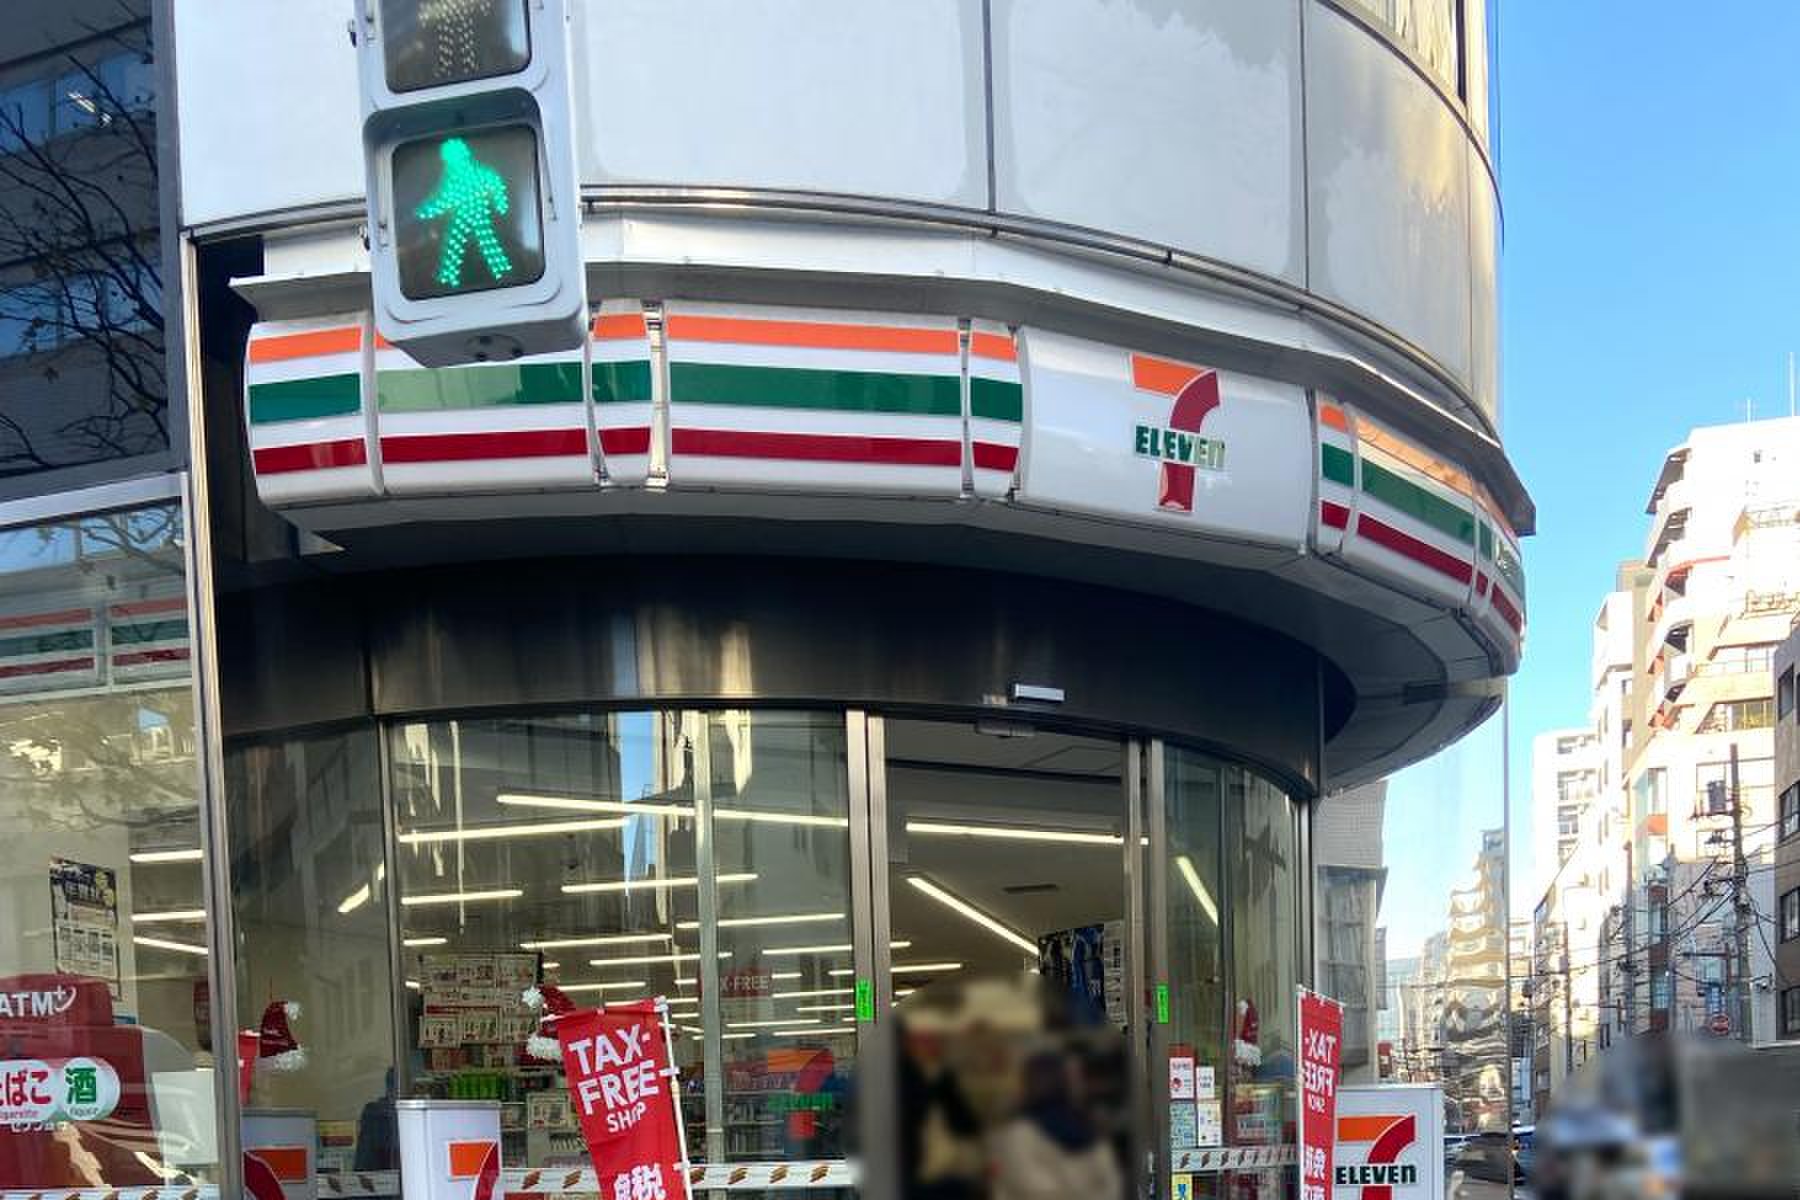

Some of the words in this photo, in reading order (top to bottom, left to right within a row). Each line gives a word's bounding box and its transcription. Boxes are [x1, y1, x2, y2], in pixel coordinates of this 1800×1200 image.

[0, 1069, 51, 1106] ばこ
[65, 1067, 97, 1105] 酒
[577, 1059, 659, 1115] FREE
